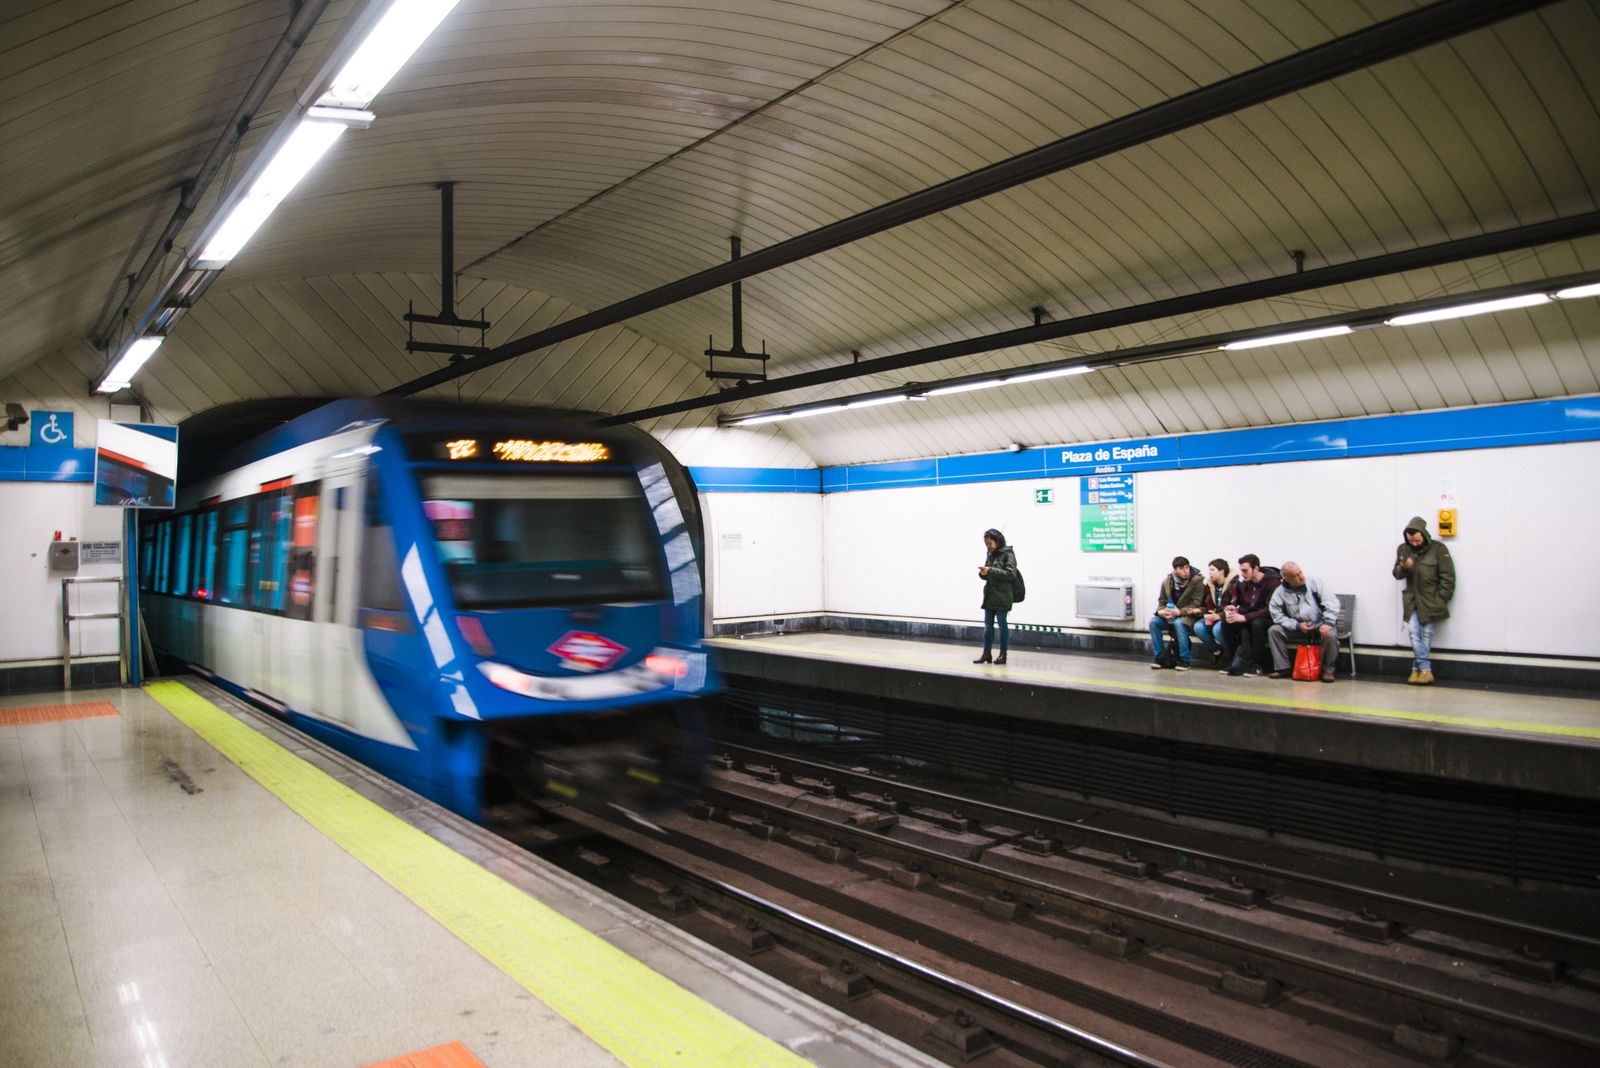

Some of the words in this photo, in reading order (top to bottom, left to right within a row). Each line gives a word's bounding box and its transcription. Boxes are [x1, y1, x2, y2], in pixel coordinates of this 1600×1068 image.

[1061, 451, 1093, 463] Plaza
[1094, 448, 1110, 461] de
[1112, 444, 1158, 461] España
